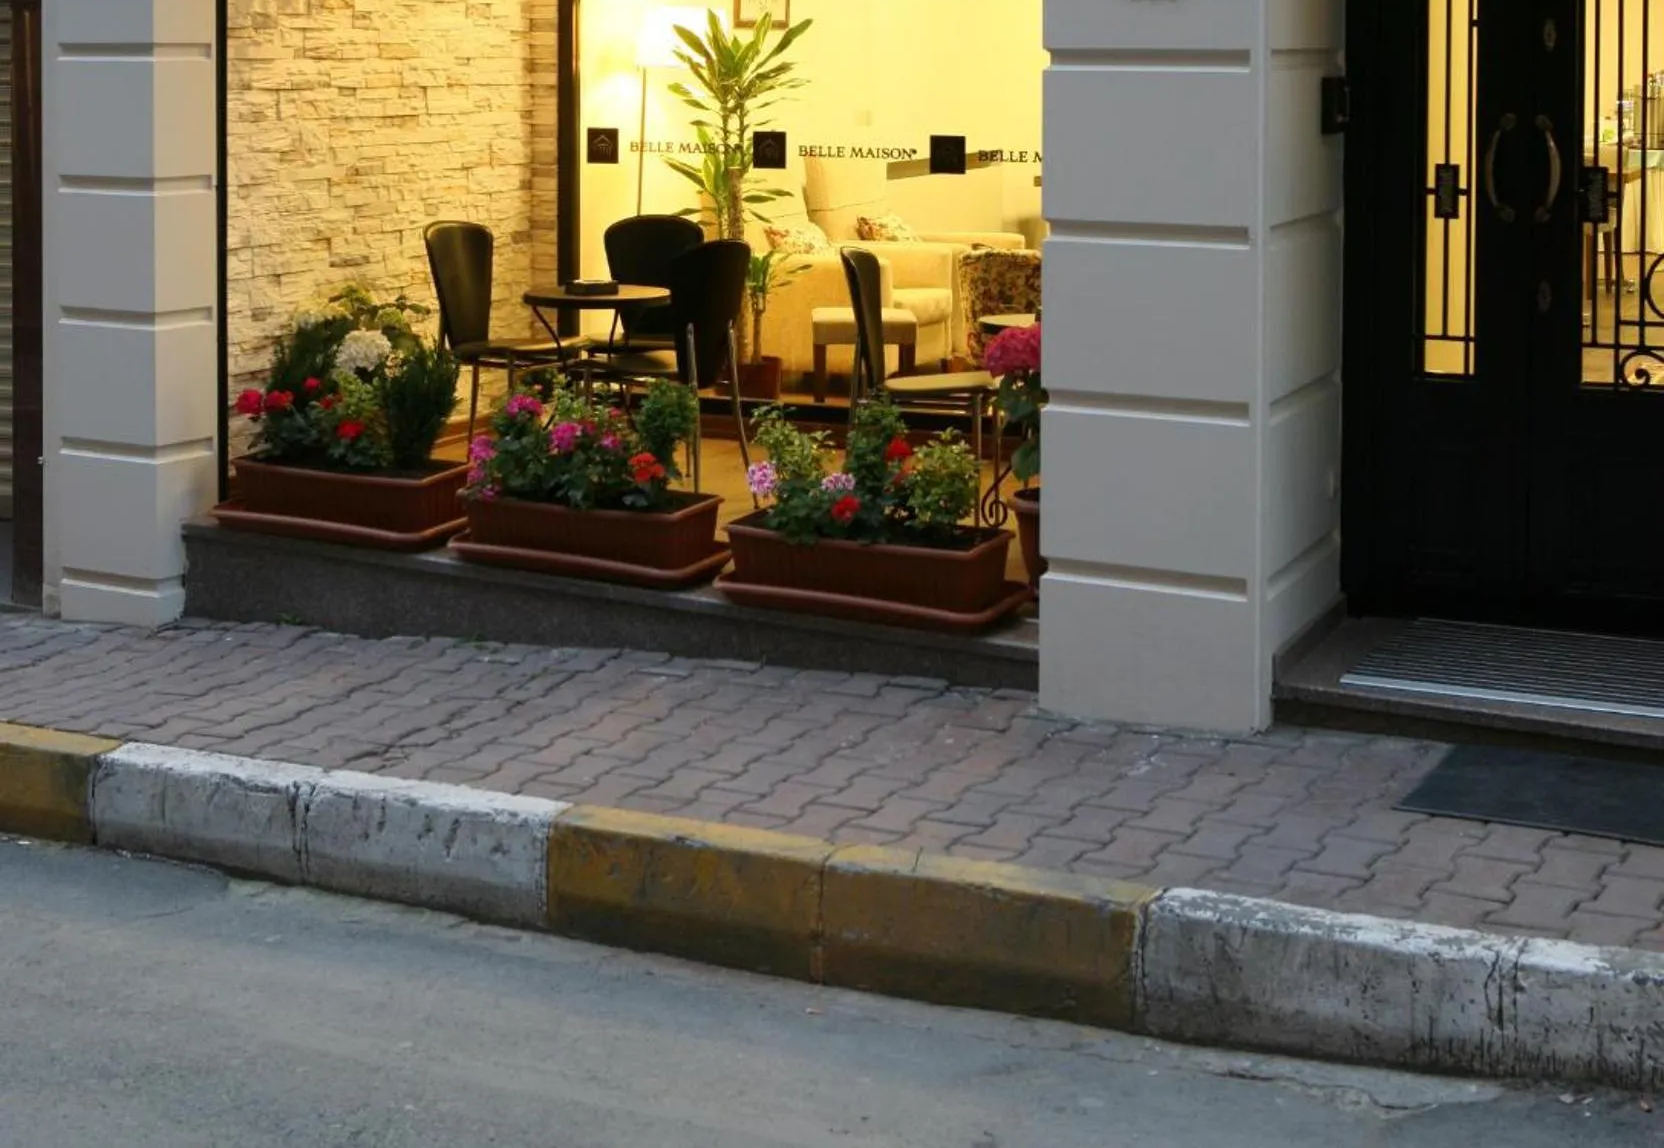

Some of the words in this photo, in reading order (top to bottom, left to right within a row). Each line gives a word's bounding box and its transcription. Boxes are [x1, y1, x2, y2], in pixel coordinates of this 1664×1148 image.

[630, 141, 674, 153] BELLE
[798, 144, 846, 158] BELLE
[978, 150, 1028, 164] BELLE
